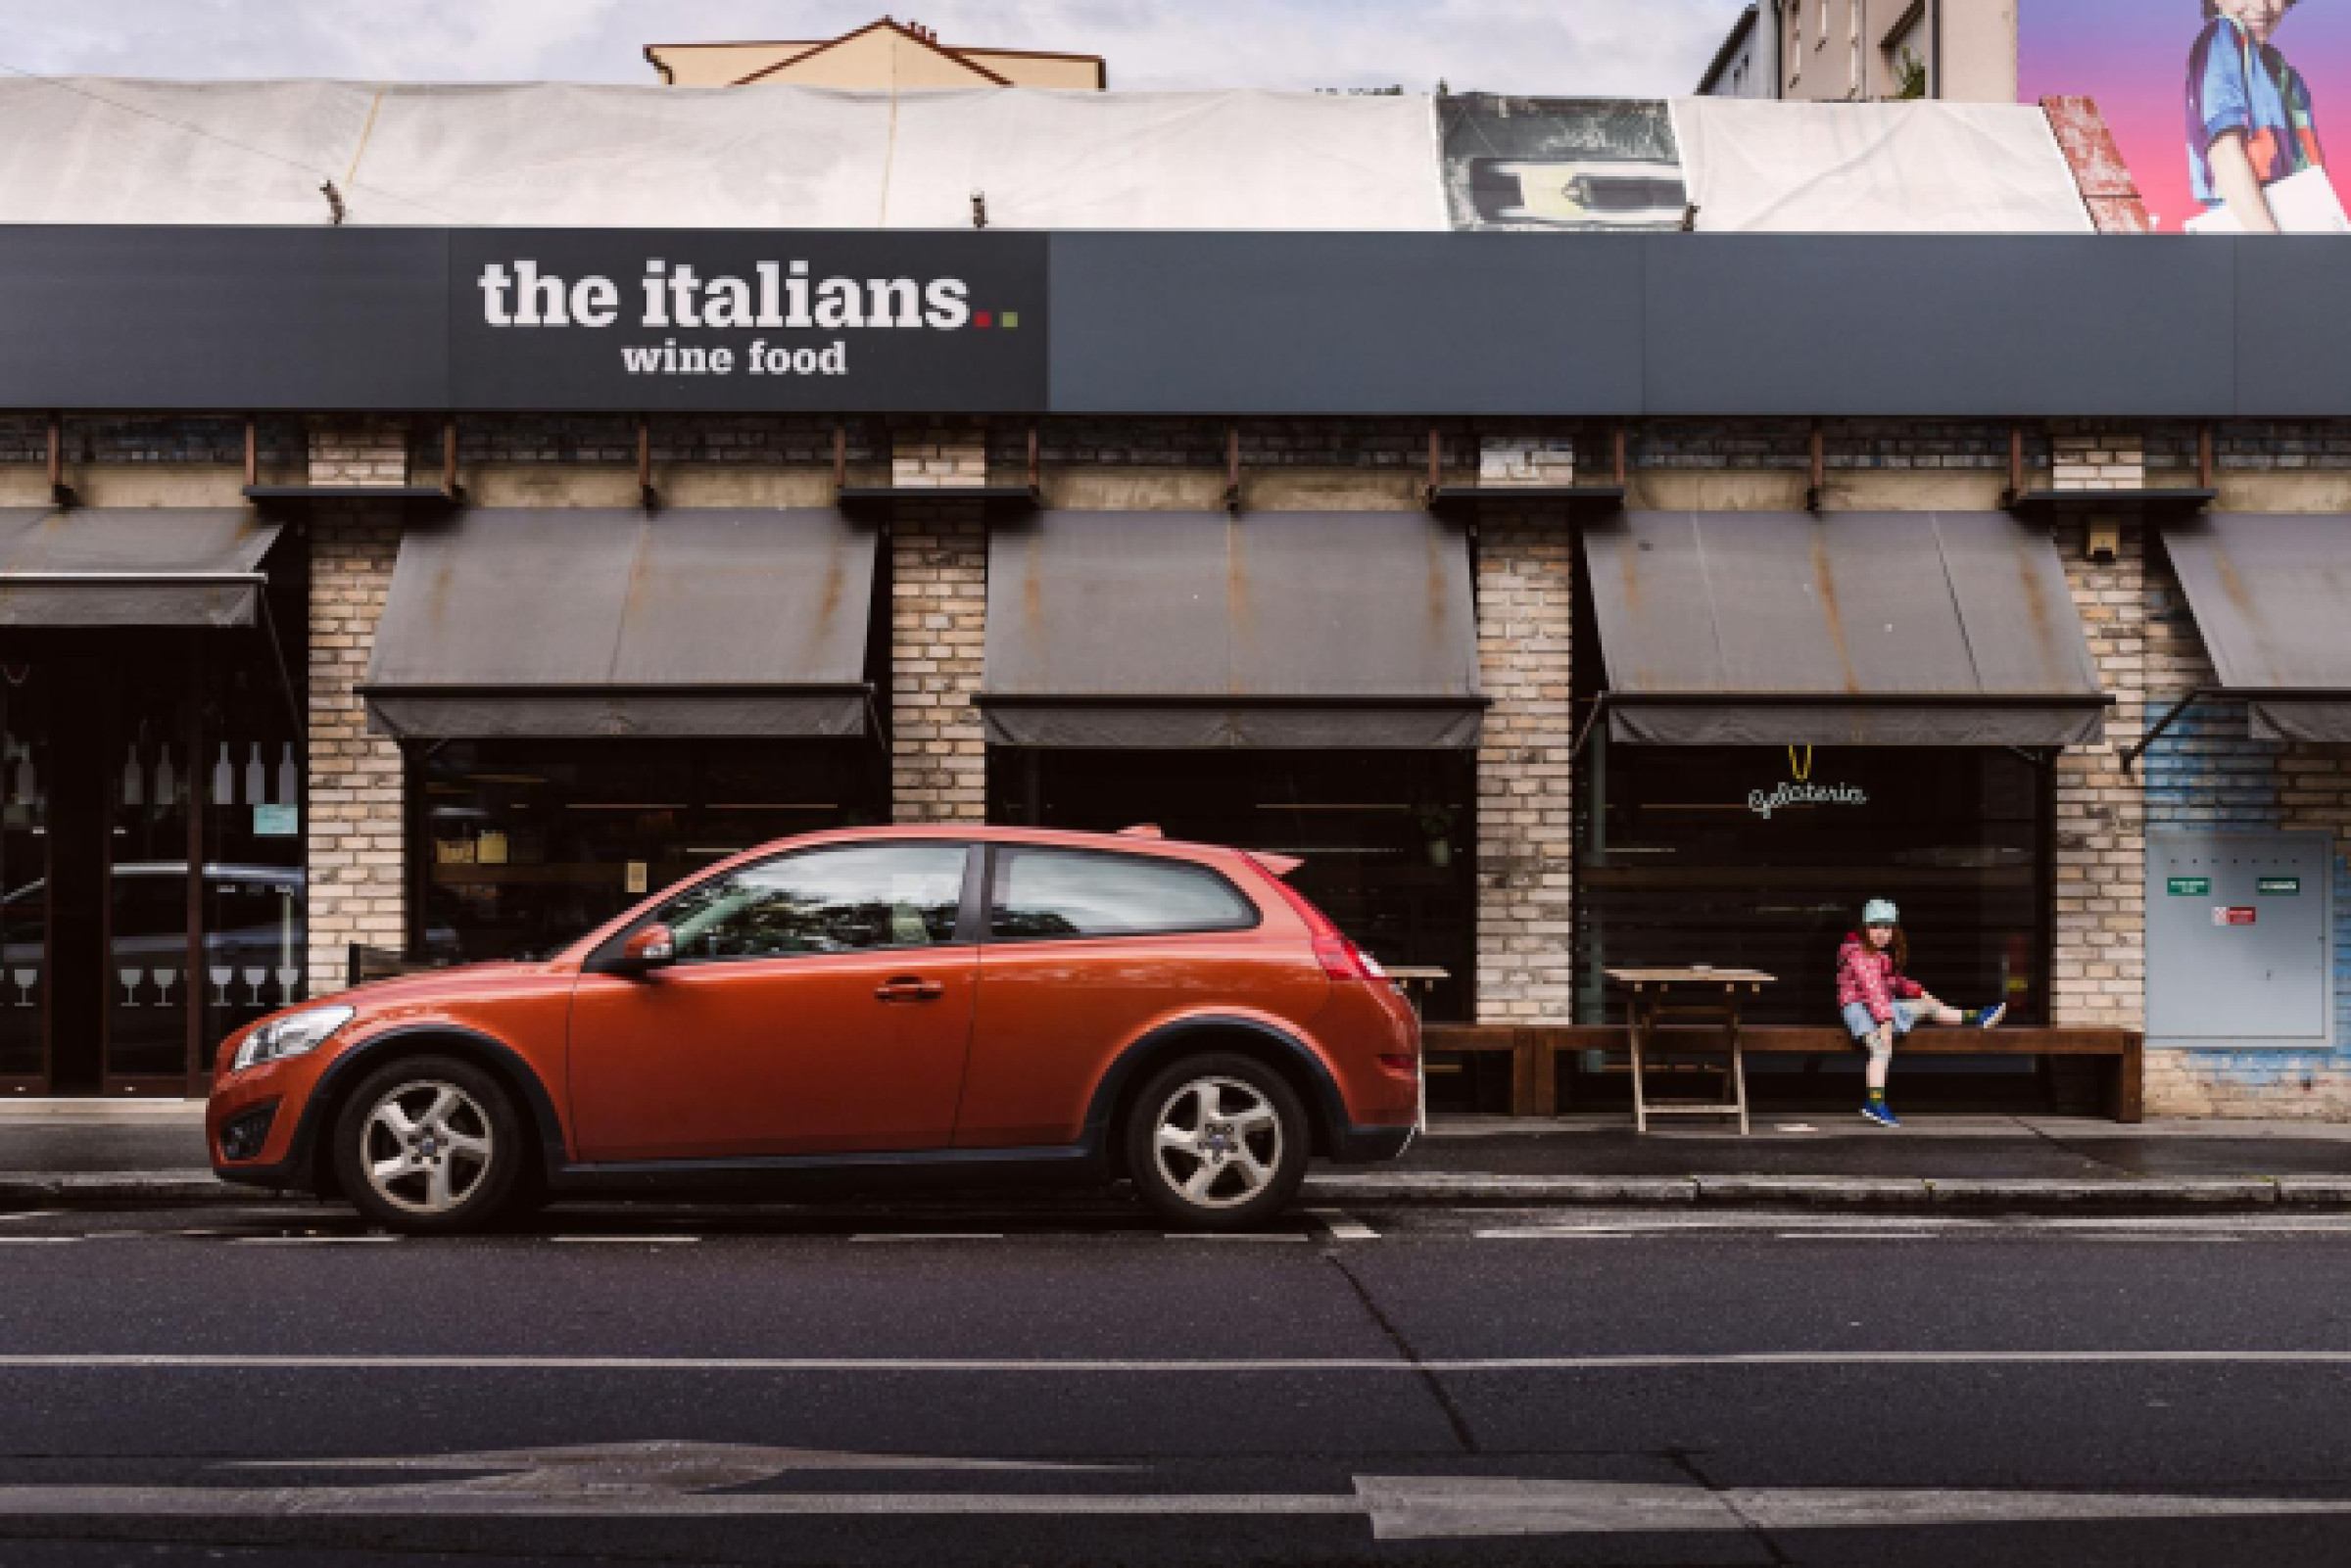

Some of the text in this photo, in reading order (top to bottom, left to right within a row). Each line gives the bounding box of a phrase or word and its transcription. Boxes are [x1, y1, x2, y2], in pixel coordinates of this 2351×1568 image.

[477, 259, 618, 329] the
[621, 337, 847, 374] wine food
